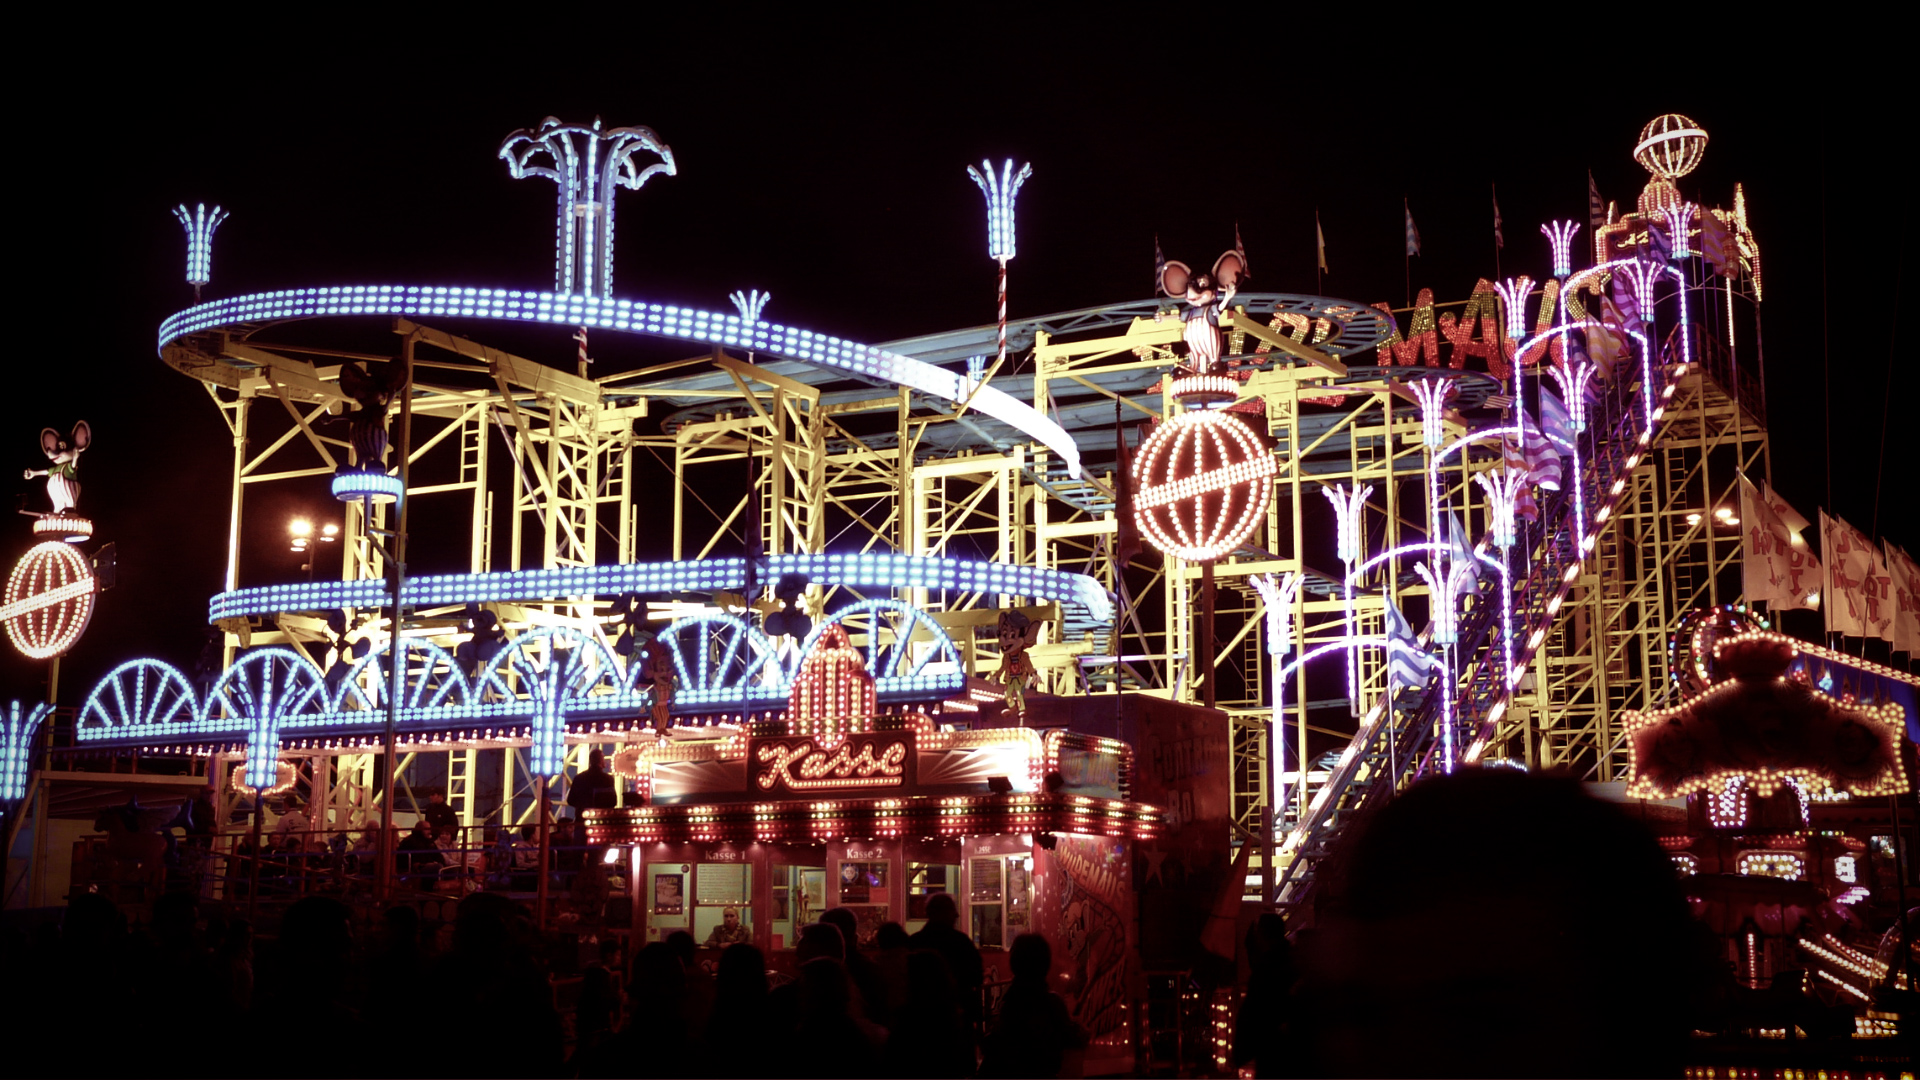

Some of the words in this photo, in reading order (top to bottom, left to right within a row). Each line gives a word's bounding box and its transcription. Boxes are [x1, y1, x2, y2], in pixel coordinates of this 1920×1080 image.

[754, 743, 907, 790] Kasse
[705, 850, 735, 860] Kasse
[741, 851, 746, 860] 1
[846, 848, 873, 859] Kasse
[875, 848, 882, 858] 2
